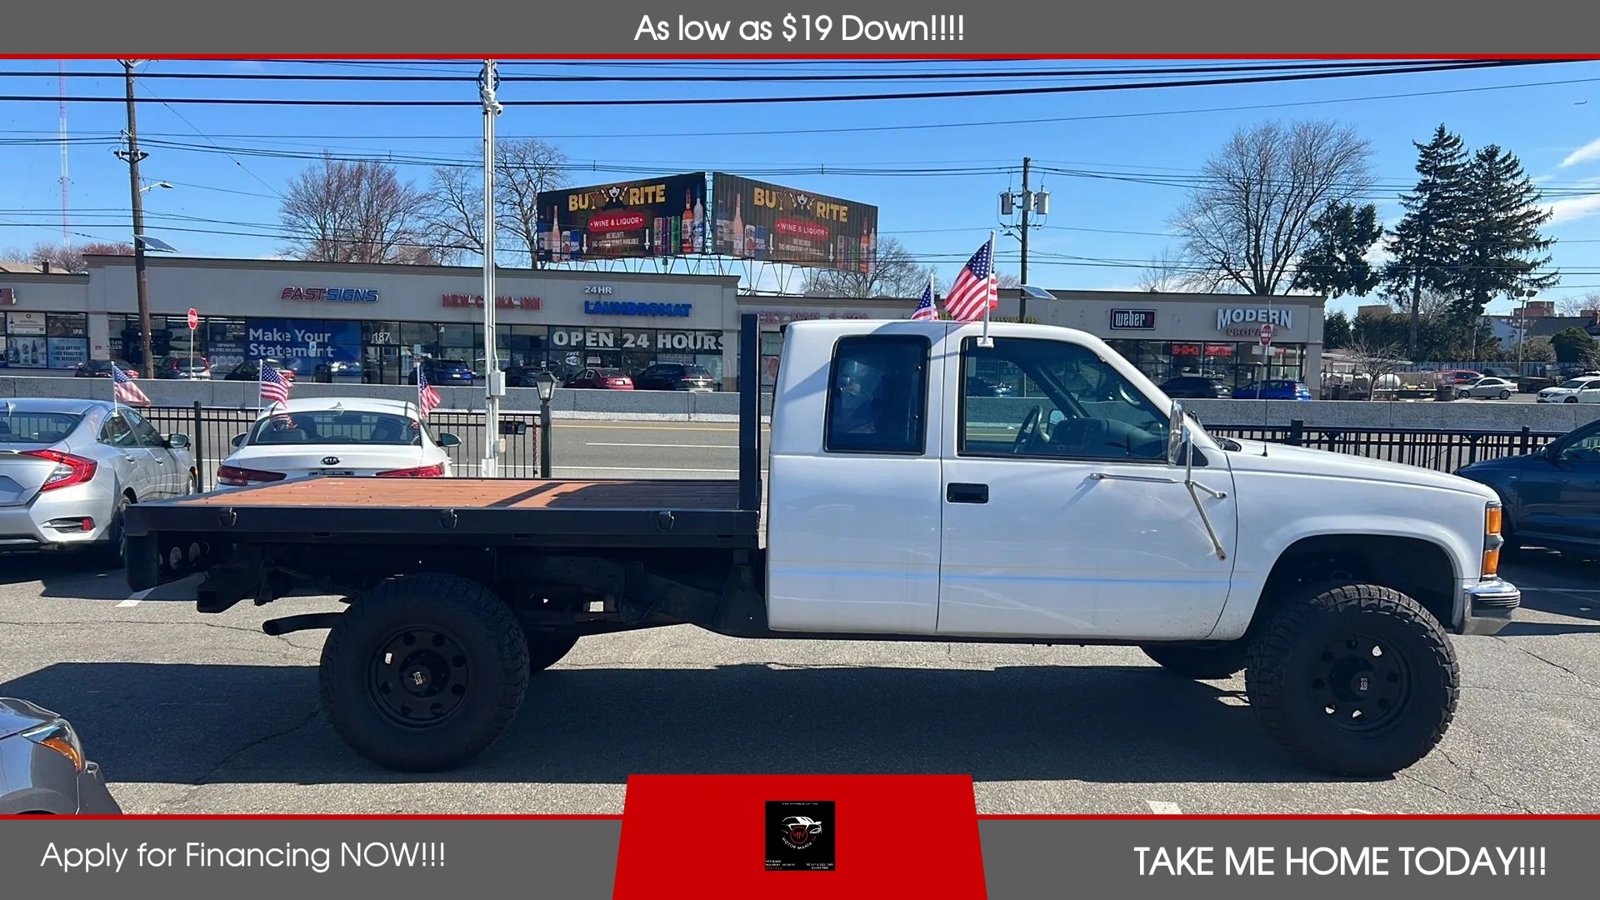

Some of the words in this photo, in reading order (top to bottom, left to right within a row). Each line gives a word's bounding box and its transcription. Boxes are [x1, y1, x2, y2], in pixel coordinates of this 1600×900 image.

[629, 184, 666, 206] RITE
[816, 200, 849, 223] RITE
[593, 218, 609, 228] WINE
[610, 219, 615, 227] &
[616, 216, 640, 226] LIQUOR
[780, 222, 797, 232] WINE
[803, 226, 825, 236] LIQUOR
[281, 287, 379, 302] FASTSIGNS
[584, 286, 612, 294] 24HR
[584, 300, 692, 318] LAUNDROMAT
[1115, 310, 1146, 327] weber
[1216, 308, 1292, 330] MODERN
[249, 328, 291, 342] Make
[295, 329, 331, 343] Your
[373, 332, 391, 342] 187
[553, 331, 614, 347] OPEN
[622, 333, 650, 348] 24
